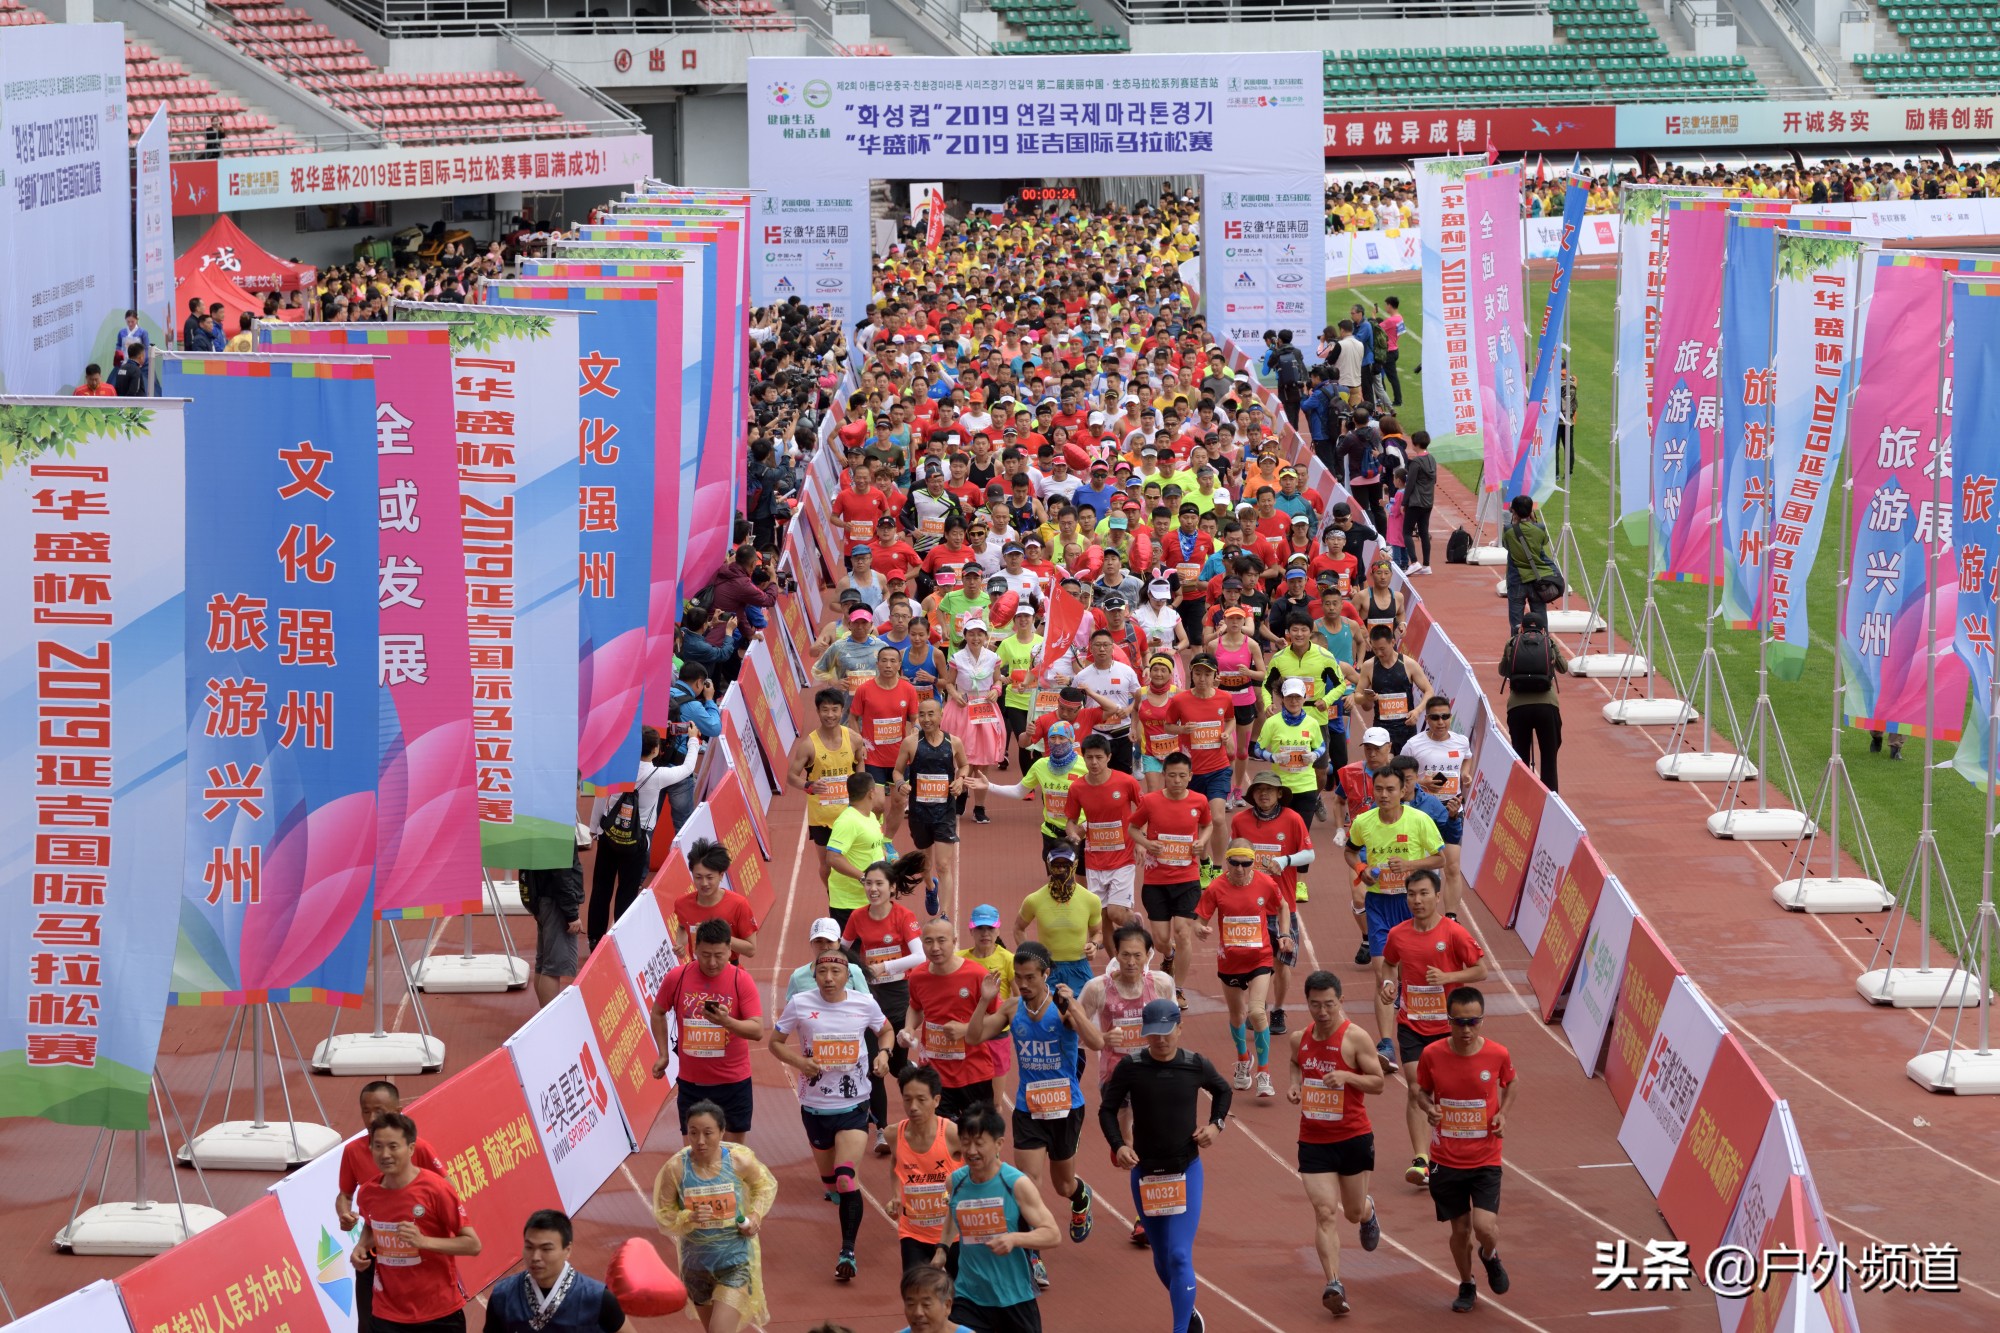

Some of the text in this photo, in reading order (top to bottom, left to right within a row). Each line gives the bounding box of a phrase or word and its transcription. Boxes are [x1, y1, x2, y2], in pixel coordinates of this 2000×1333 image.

[649, 48, 697, 72] 出口
[767, 113, 815, 126] 健康生活
[1016, 101, 1213, 127] 연길국제마라톤경기
[1783, 107, 1994, 133] 开诚务实 励精创新
[783, 127, 831, 139] 悦动吉林
[1016, 131, 1213, 154] 延吉国际马拉松赛
[1022, 188, 1077, 200] 00:00:24
[783, 225, 849, 238] 安徽华盛集团
[1243, 220, 1309, 233] 安徽华盛集团
[1662, 338, 1704, 522] 旅游兴州
[1859, 425, 1922, 658] 旅游兴州
[1957, 474, 1999, 701] 旅游兴
[276, 440, 338, 751] 文化强州
[1194, 729, 1220, 740] M0156
[203, 592, 269, 906] 旅游兴州
[1092, 830, 1120, 840] M0209
[1162, 845, 1190, 854] M0439
[1227, 926, 1257, 936] M0357
[1411, 996, 1441, 1007] M0231
[687, 1031, 721, 1042] M0178
[818, 1044, 855, 1056] M0145
[1018, 1039, 1061, 1057] XRC
[1031, 1090, 1067, 1105] M0008
[1306, 1091, 1339, 1105] M0219
[1445, 1110, 1482, 1123] M0328
[481, 1112, 540, 1181] 旅游兴州
[1146, 1186, 1181, 1201] M0321
[961, 1211, 1000, 1227] M0216
